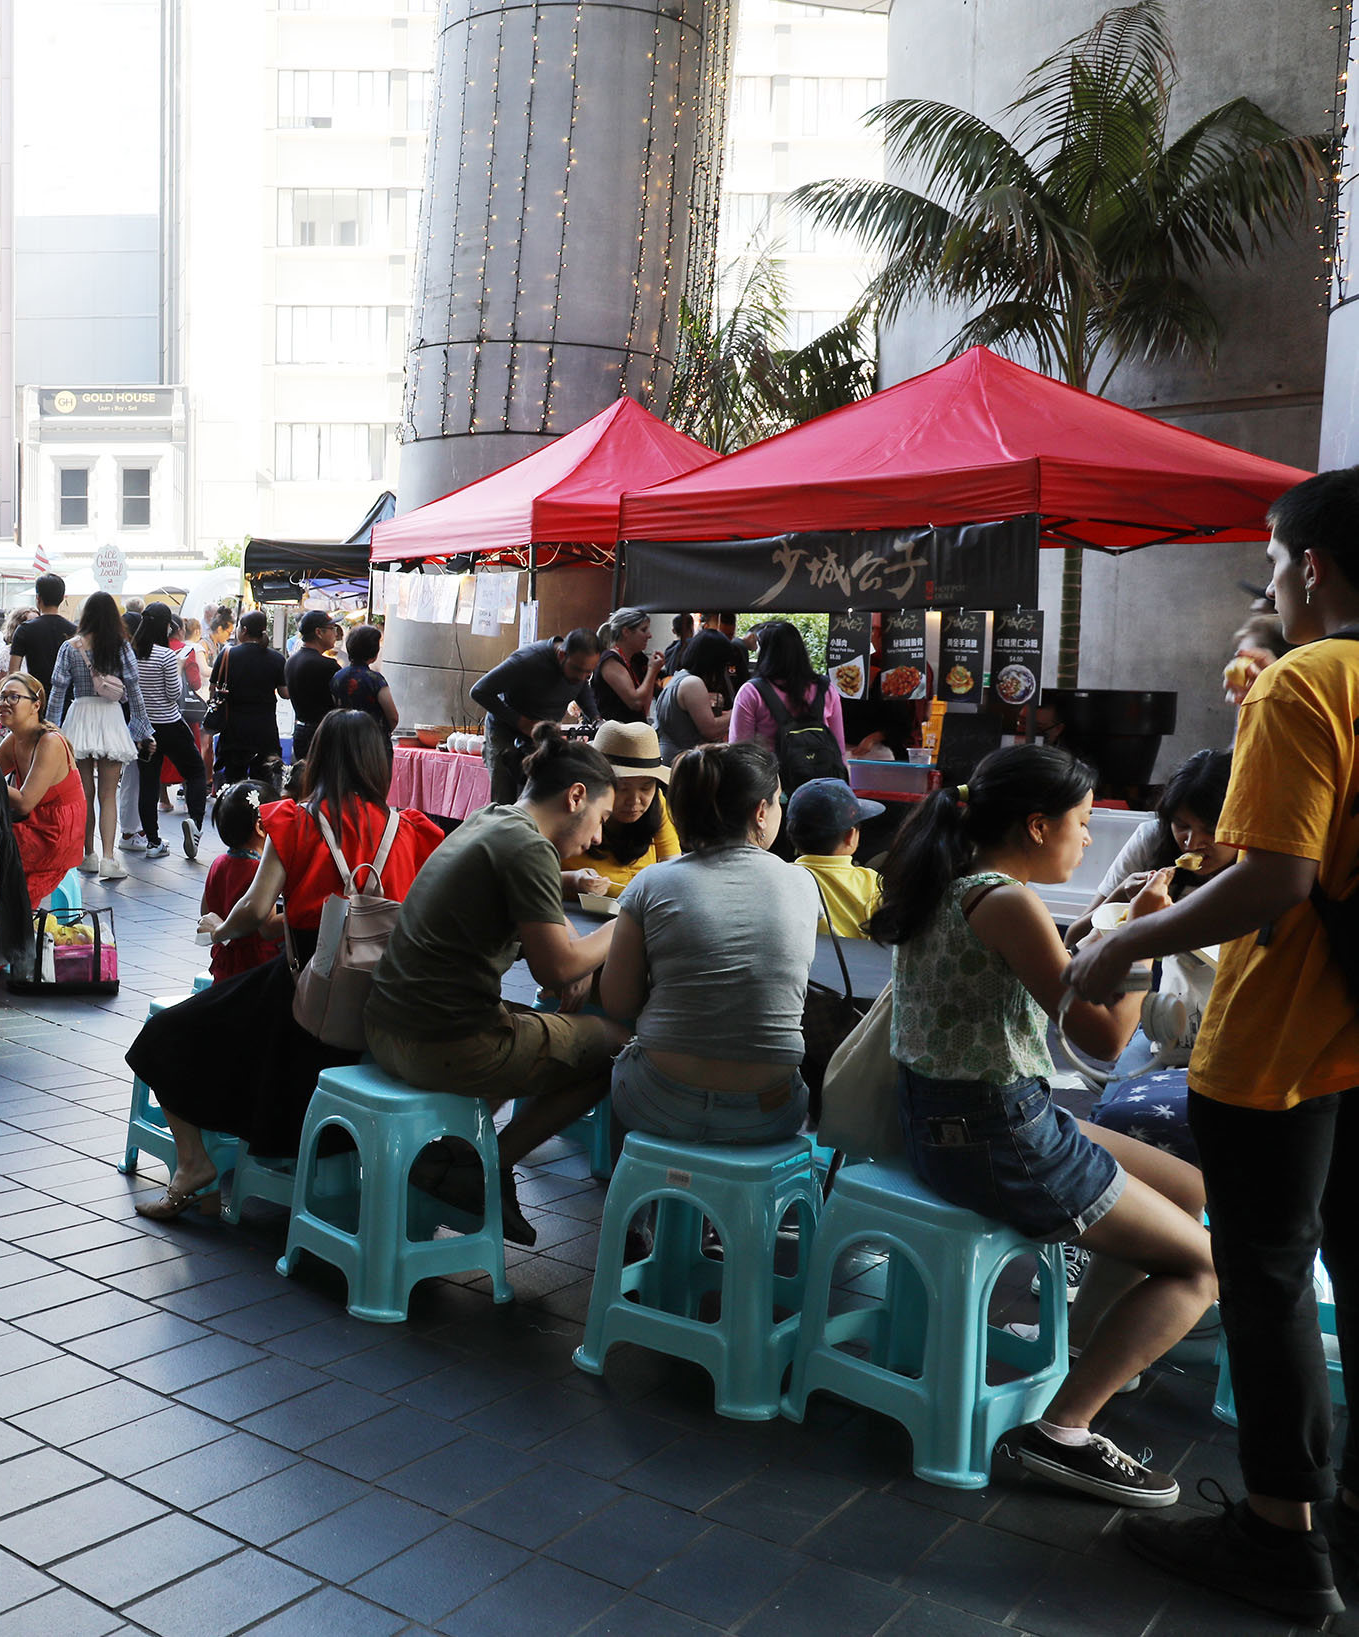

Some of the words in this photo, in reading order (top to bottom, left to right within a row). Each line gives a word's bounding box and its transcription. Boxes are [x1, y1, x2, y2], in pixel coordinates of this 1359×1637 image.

[58, 398, 73, 407] GH
[82, 393, 113, 403] GOLD
[116, 393, 156, 403] HOUSE
